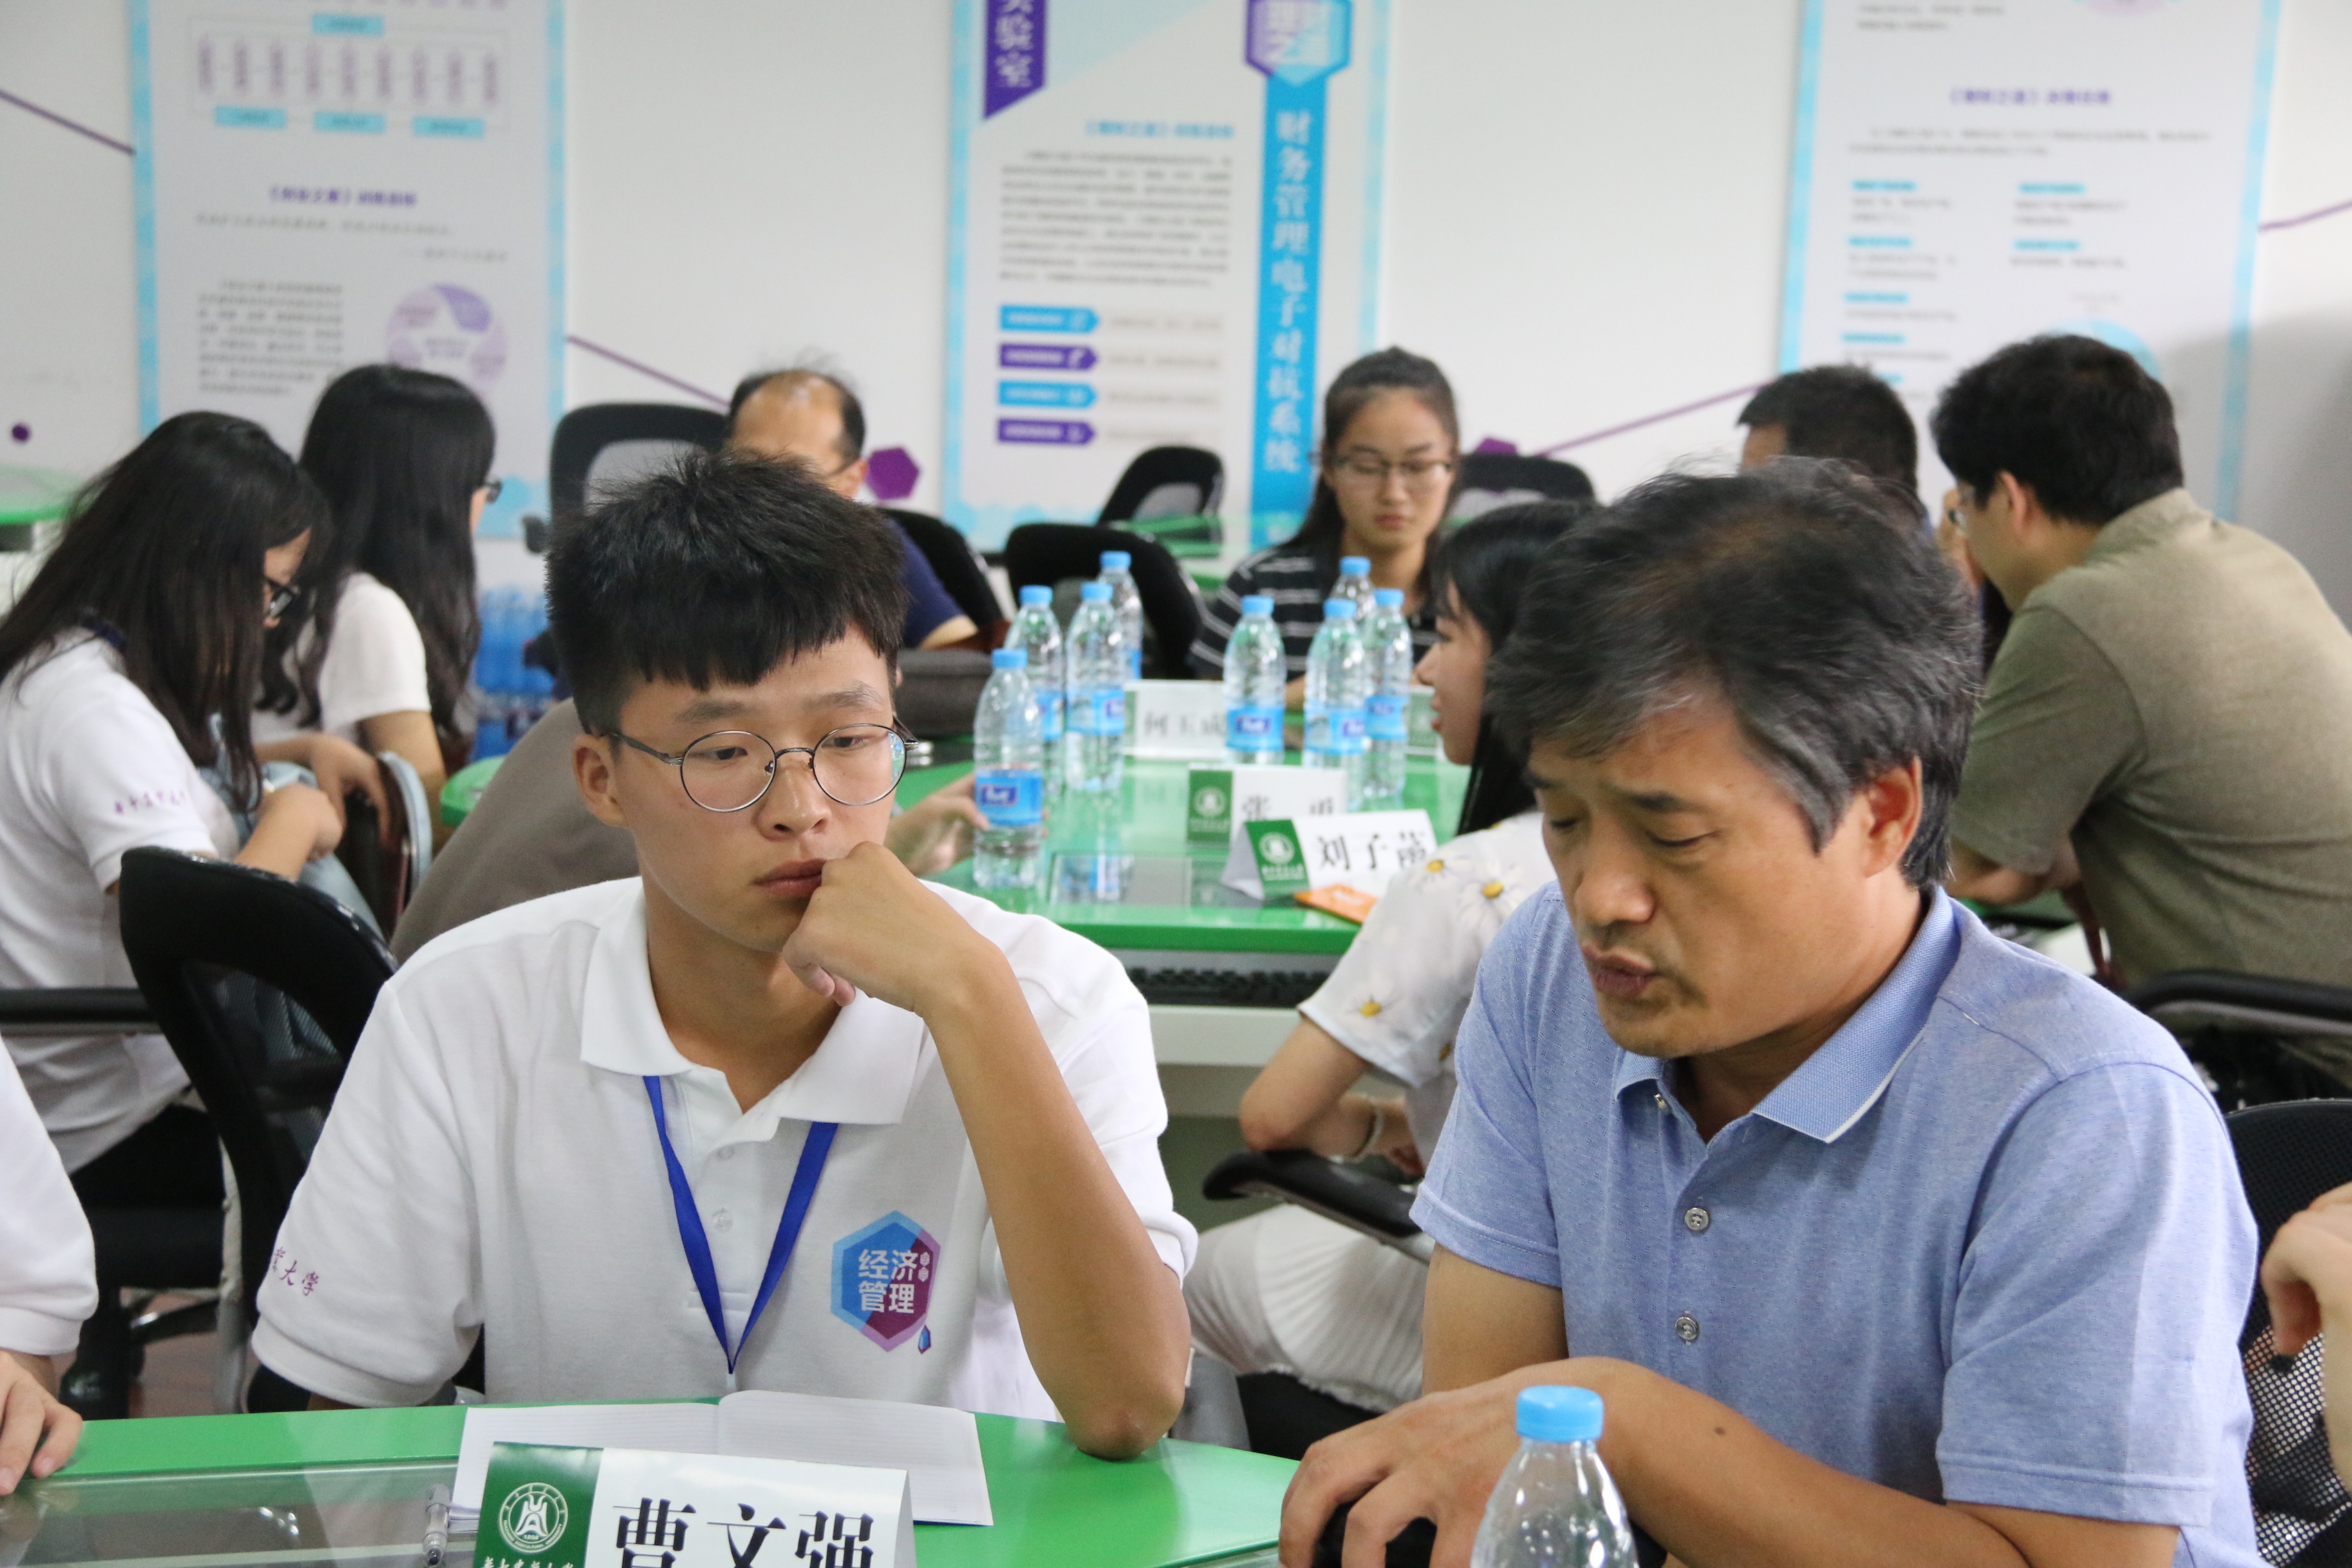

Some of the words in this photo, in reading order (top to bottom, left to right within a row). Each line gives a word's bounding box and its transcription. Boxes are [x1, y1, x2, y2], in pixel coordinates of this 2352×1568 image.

[858, 1249, 919, 1281] 经济
[858, 1280, 915, 1314] 管理
[613, 1496, 875, 1568] 曹文强
